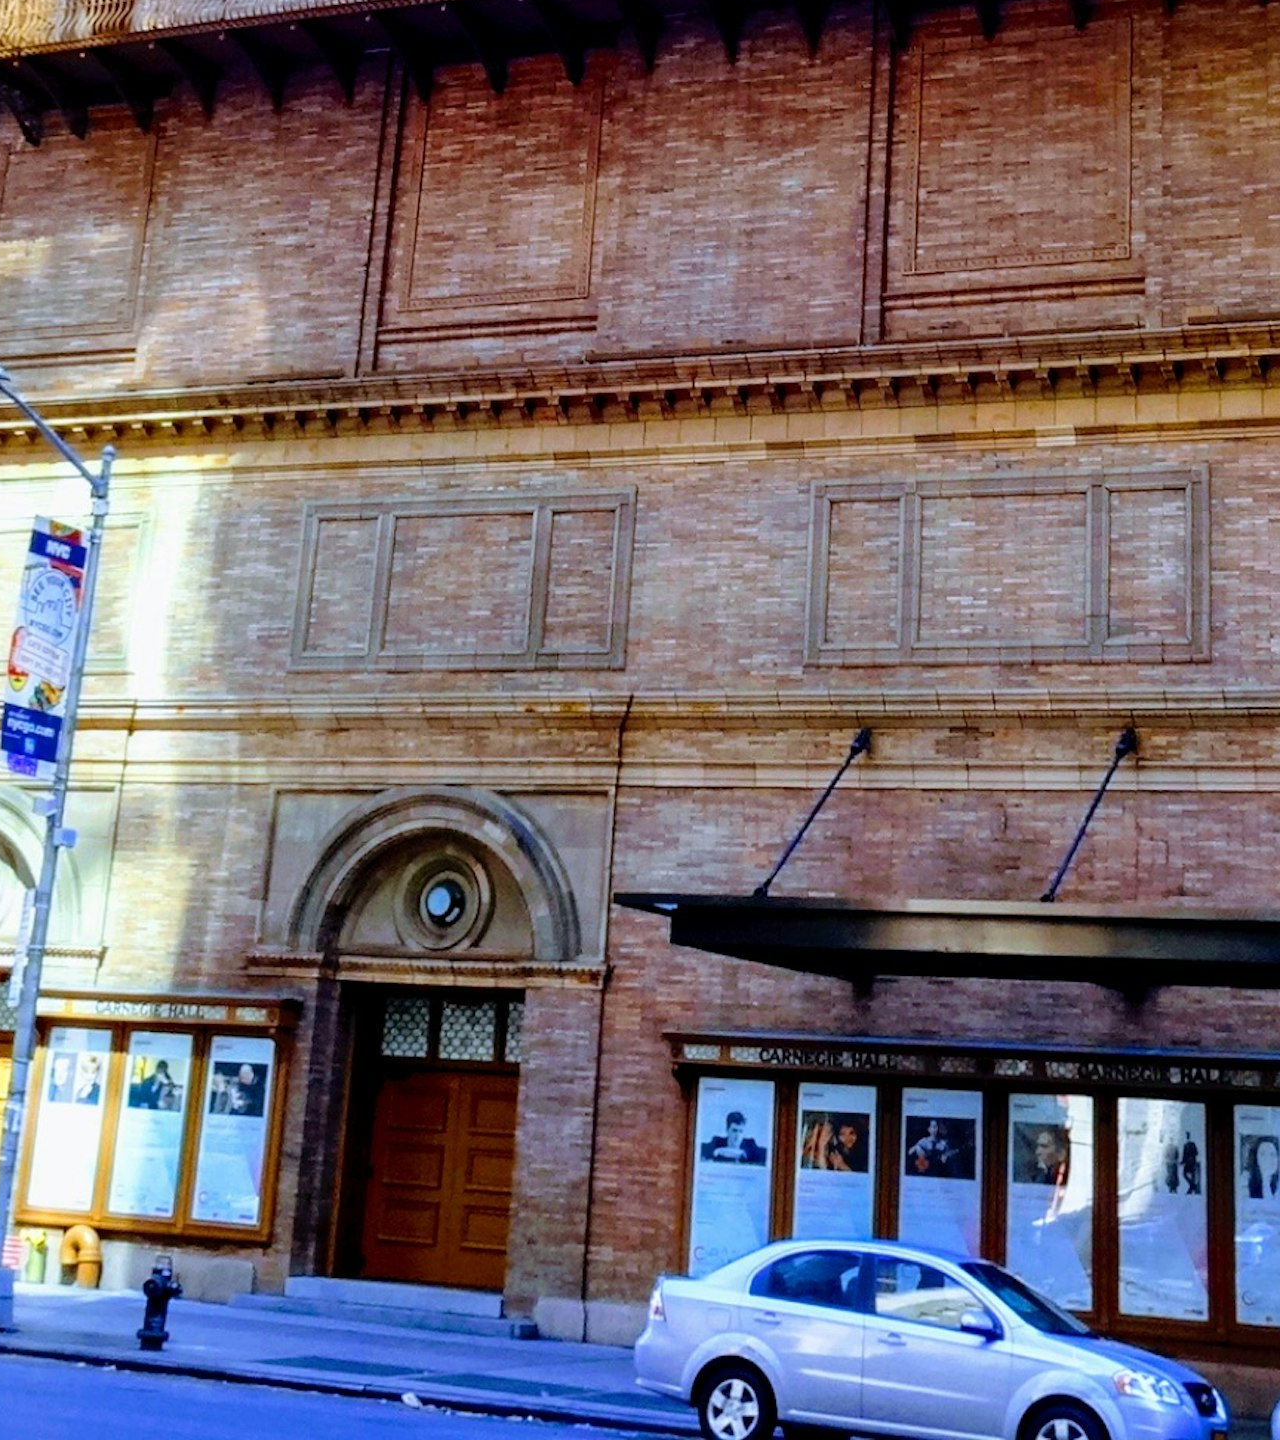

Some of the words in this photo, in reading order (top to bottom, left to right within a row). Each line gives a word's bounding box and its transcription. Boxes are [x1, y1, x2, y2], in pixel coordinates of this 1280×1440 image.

[45, 539, 71, 559] NYC
[94, 1000, 162, 1018] CARNEGIE
[168, 1003, 205, 1020] HALL
[758, 1048, 844, 1067] CARNEGIE
[850, 1051, 897, 1070] HALL
[1179, 1065, 1230, 1085] HALL
